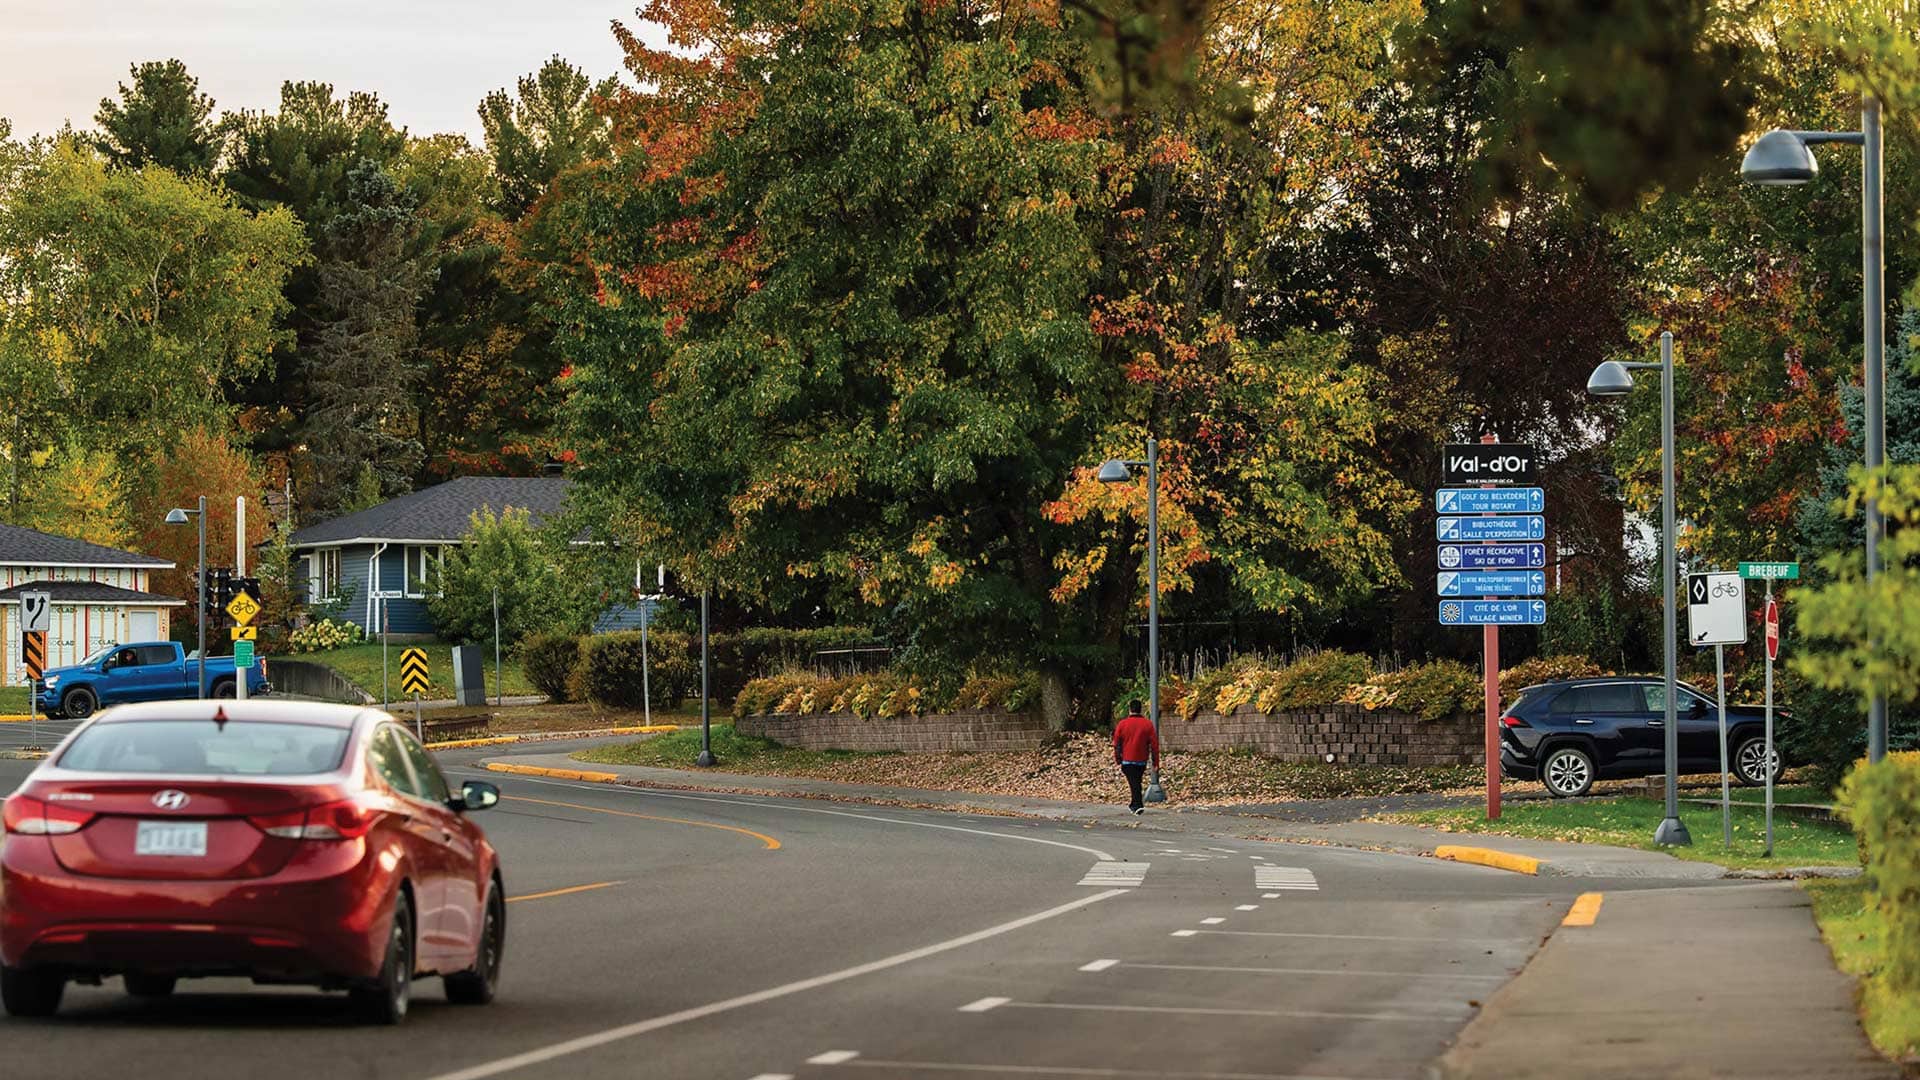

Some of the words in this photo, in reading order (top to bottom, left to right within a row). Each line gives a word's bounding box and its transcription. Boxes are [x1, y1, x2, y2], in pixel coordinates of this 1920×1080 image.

[1450, 456, 1528, 472] Val-d'Or
[1485, 530, 1527, 538] D'EXPOSITION
[1464, 546, 1484, 555] FORÊT
[1487, 546, 1525, 555] RÉCRÉATIVE
